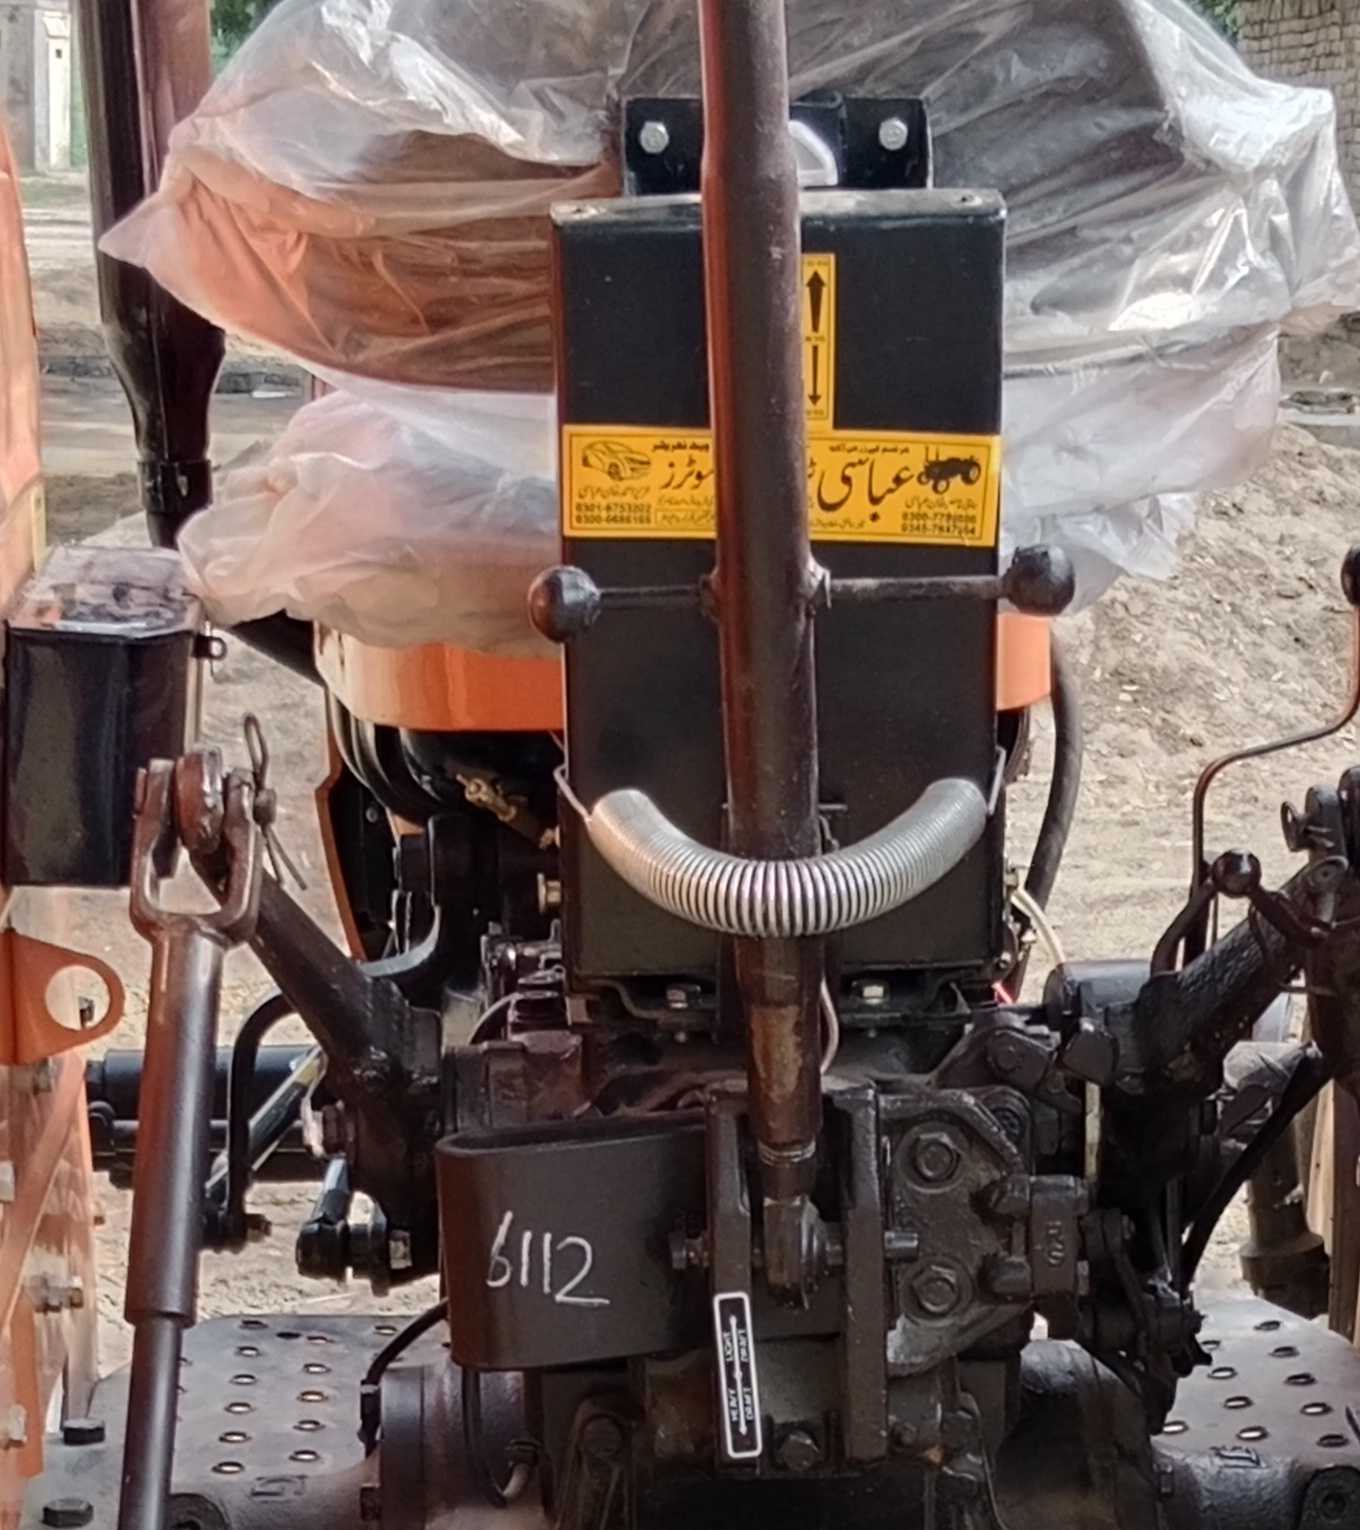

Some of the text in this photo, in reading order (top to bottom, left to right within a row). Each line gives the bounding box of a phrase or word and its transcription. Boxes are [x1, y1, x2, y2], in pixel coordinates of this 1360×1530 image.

[658, 453, 716, 491] وٹرز
[816, 454, 916, 524] عباسی
[485, 1209, 611, 1307] 6112
[722, 1330, 733, 1363] LIGHT
